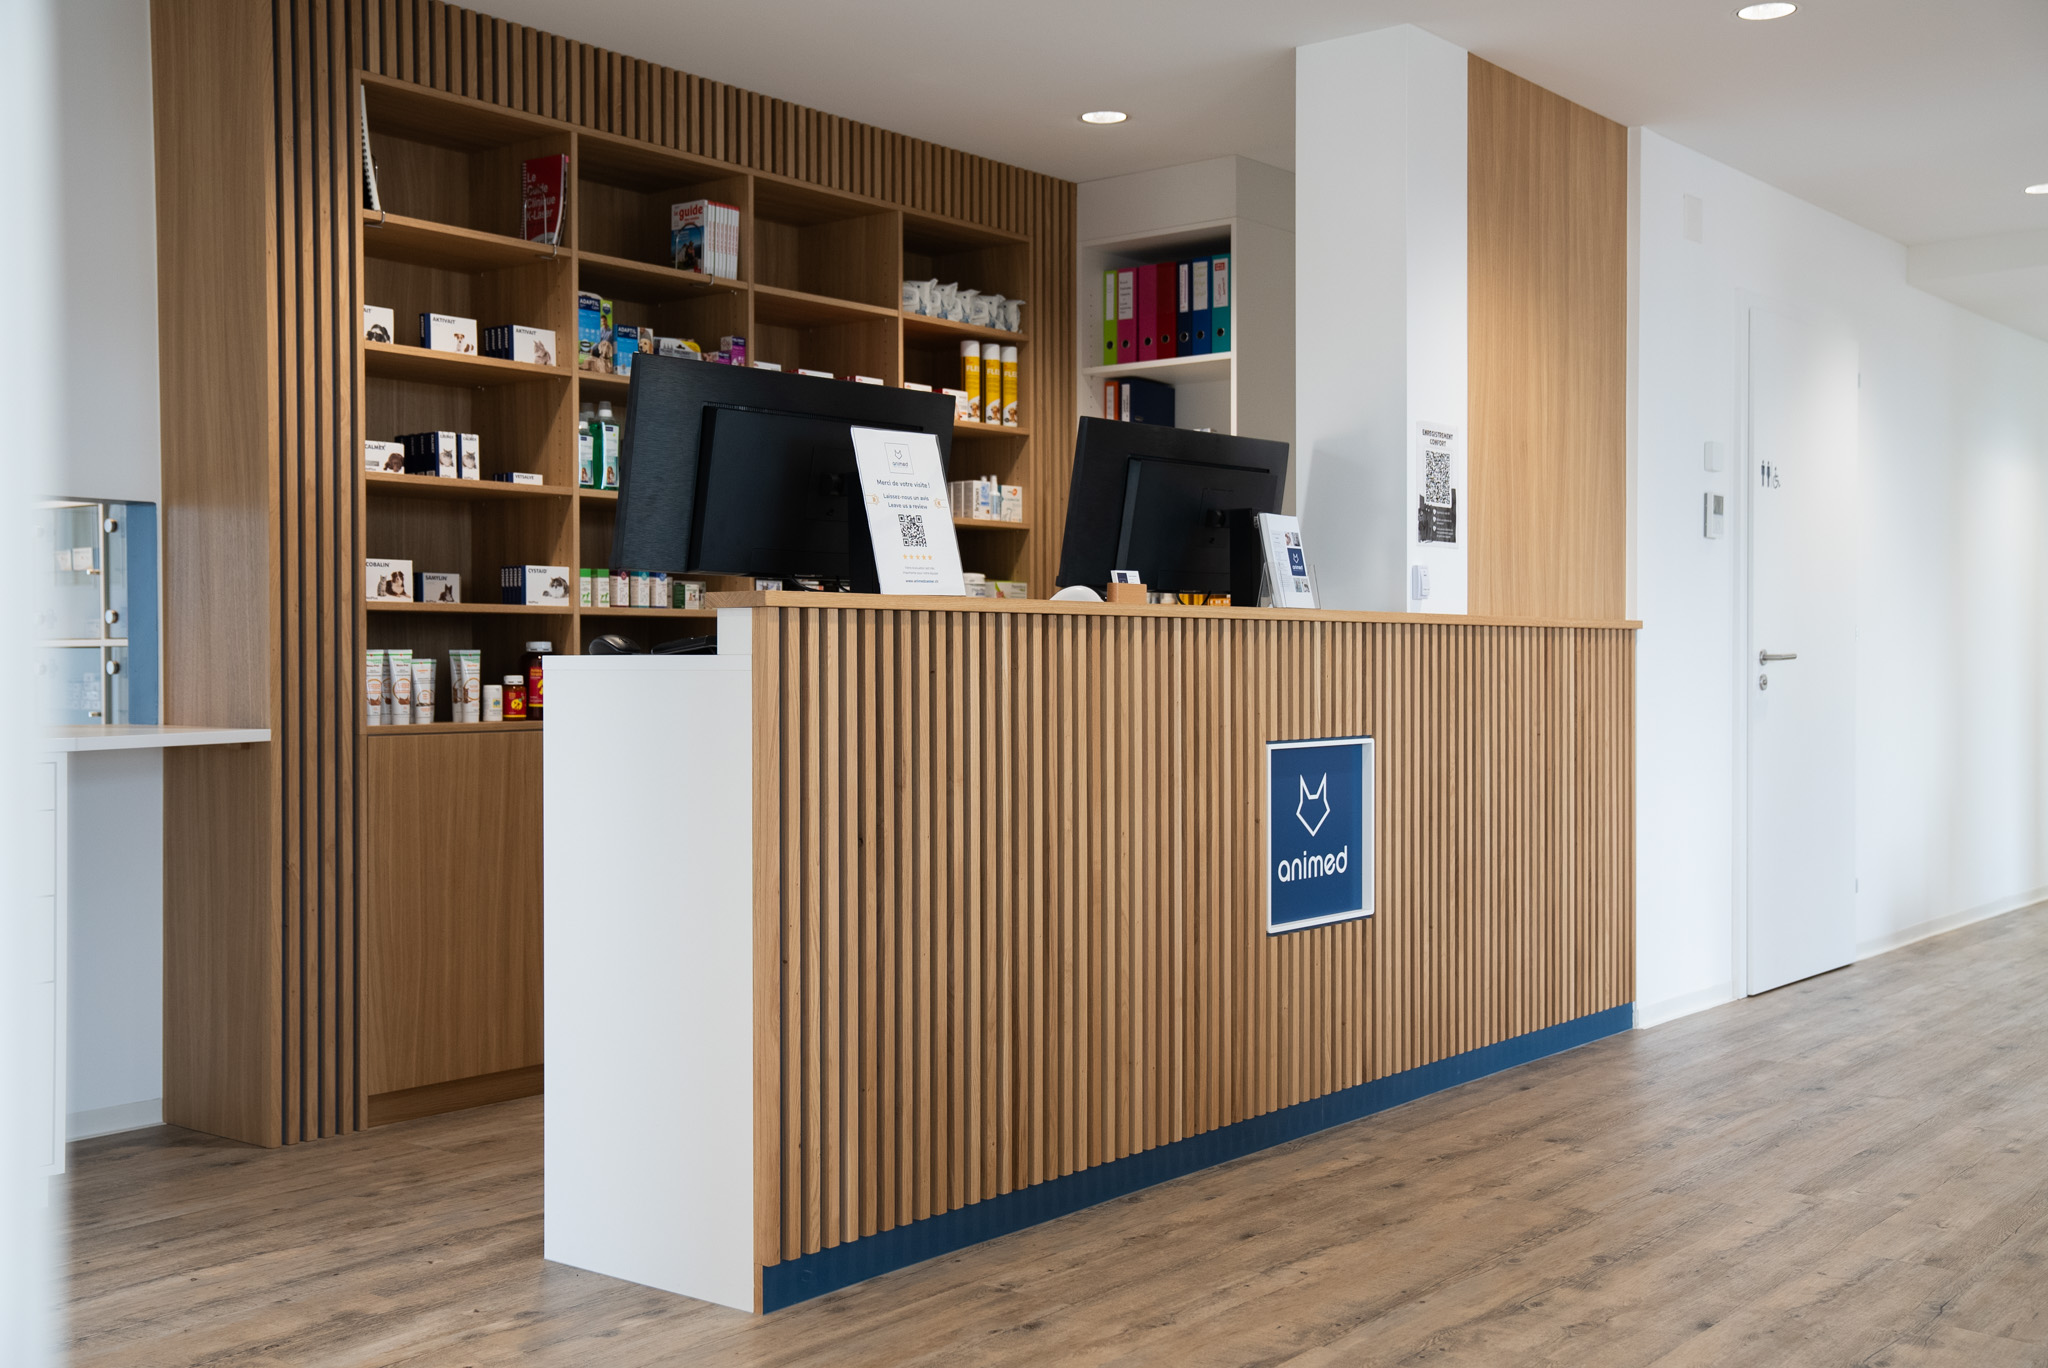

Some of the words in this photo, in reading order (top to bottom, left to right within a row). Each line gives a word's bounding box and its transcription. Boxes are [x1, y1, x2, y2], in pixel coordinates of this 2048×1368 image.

[526, 172, 537, 183] Le
[679, 203, 704, 221] guide
[579, 297, 600, 307] ADAPTIL
[432, 316, 456, 325] AKTIVAIT
[1422, 428, 1454, 440] ENREGISTREMENT
[1429, 438, 1447, 447] CONFORT
[1277, 844, 1348, 883] animed
